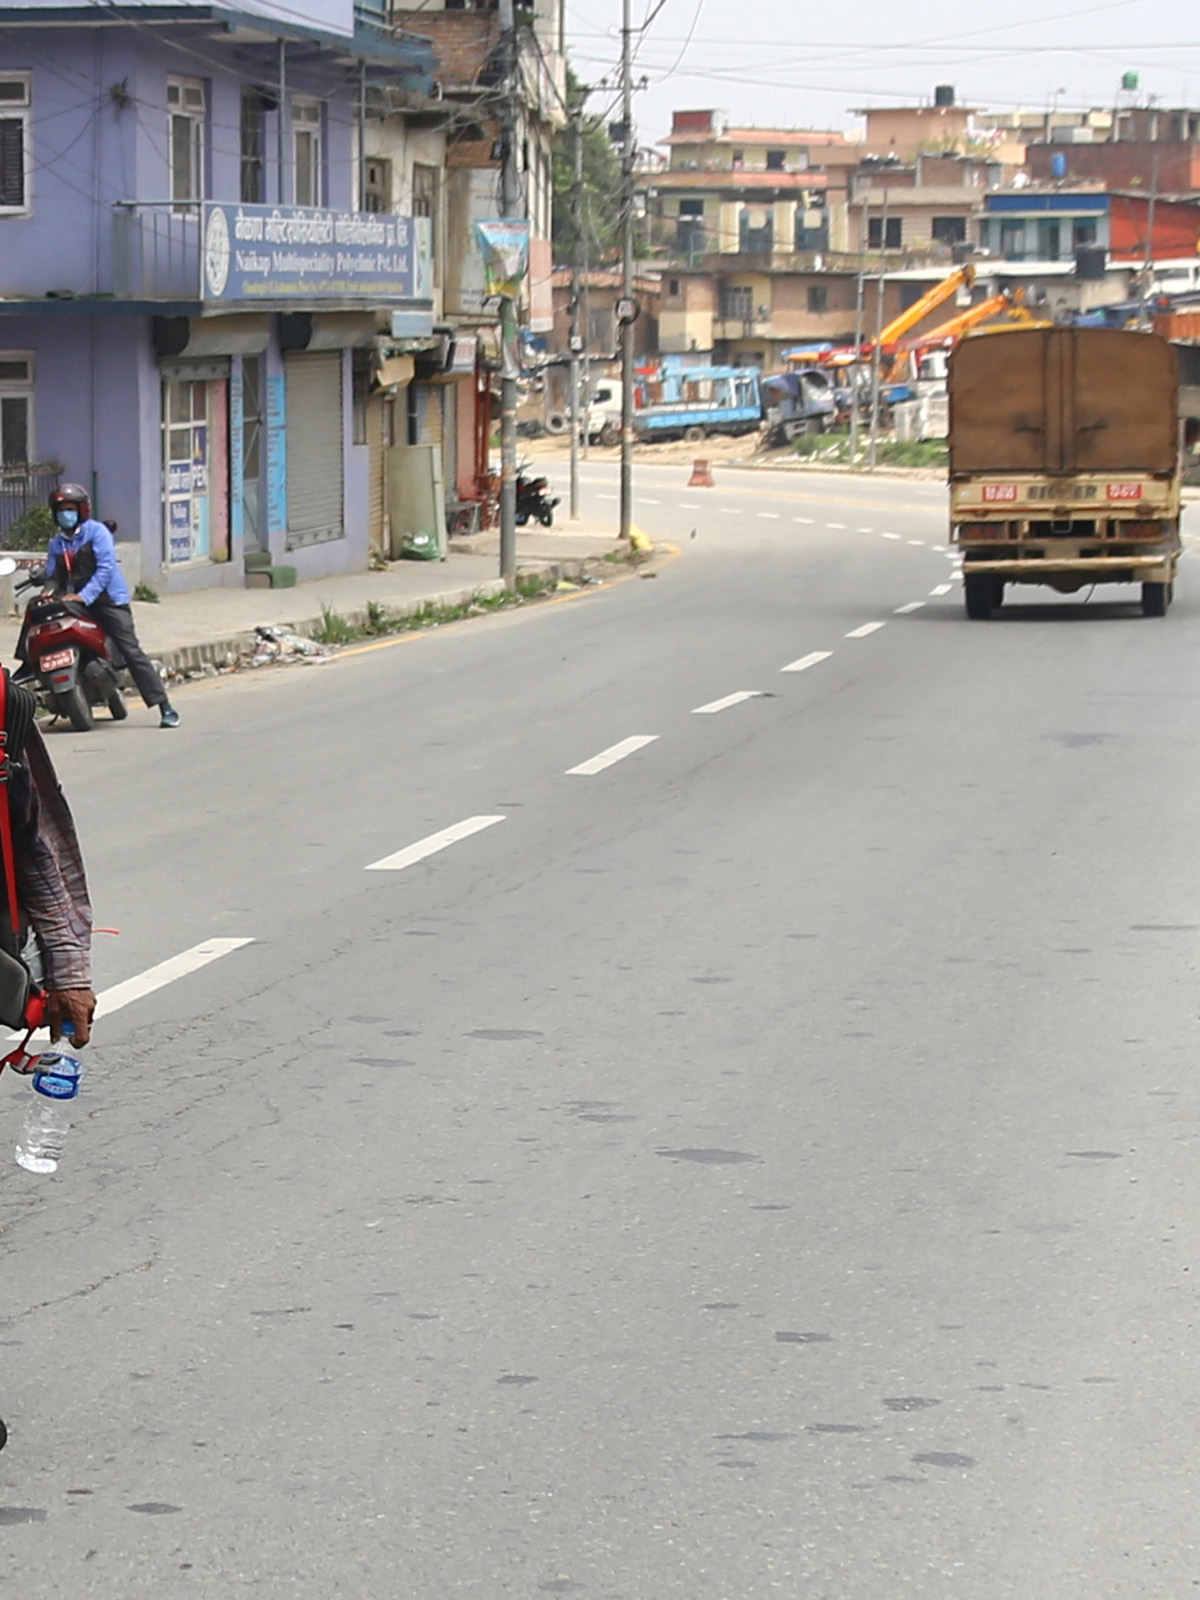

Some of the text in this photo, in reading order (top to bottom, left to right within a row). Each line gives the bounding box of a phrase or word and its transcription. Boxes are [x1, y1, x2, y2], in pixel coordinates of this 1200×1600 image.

[236, 250, 271, 277] Naikap
[337, 252, 376, 277] Polyclinic
[1027, 485, 1098, 500] EICER
